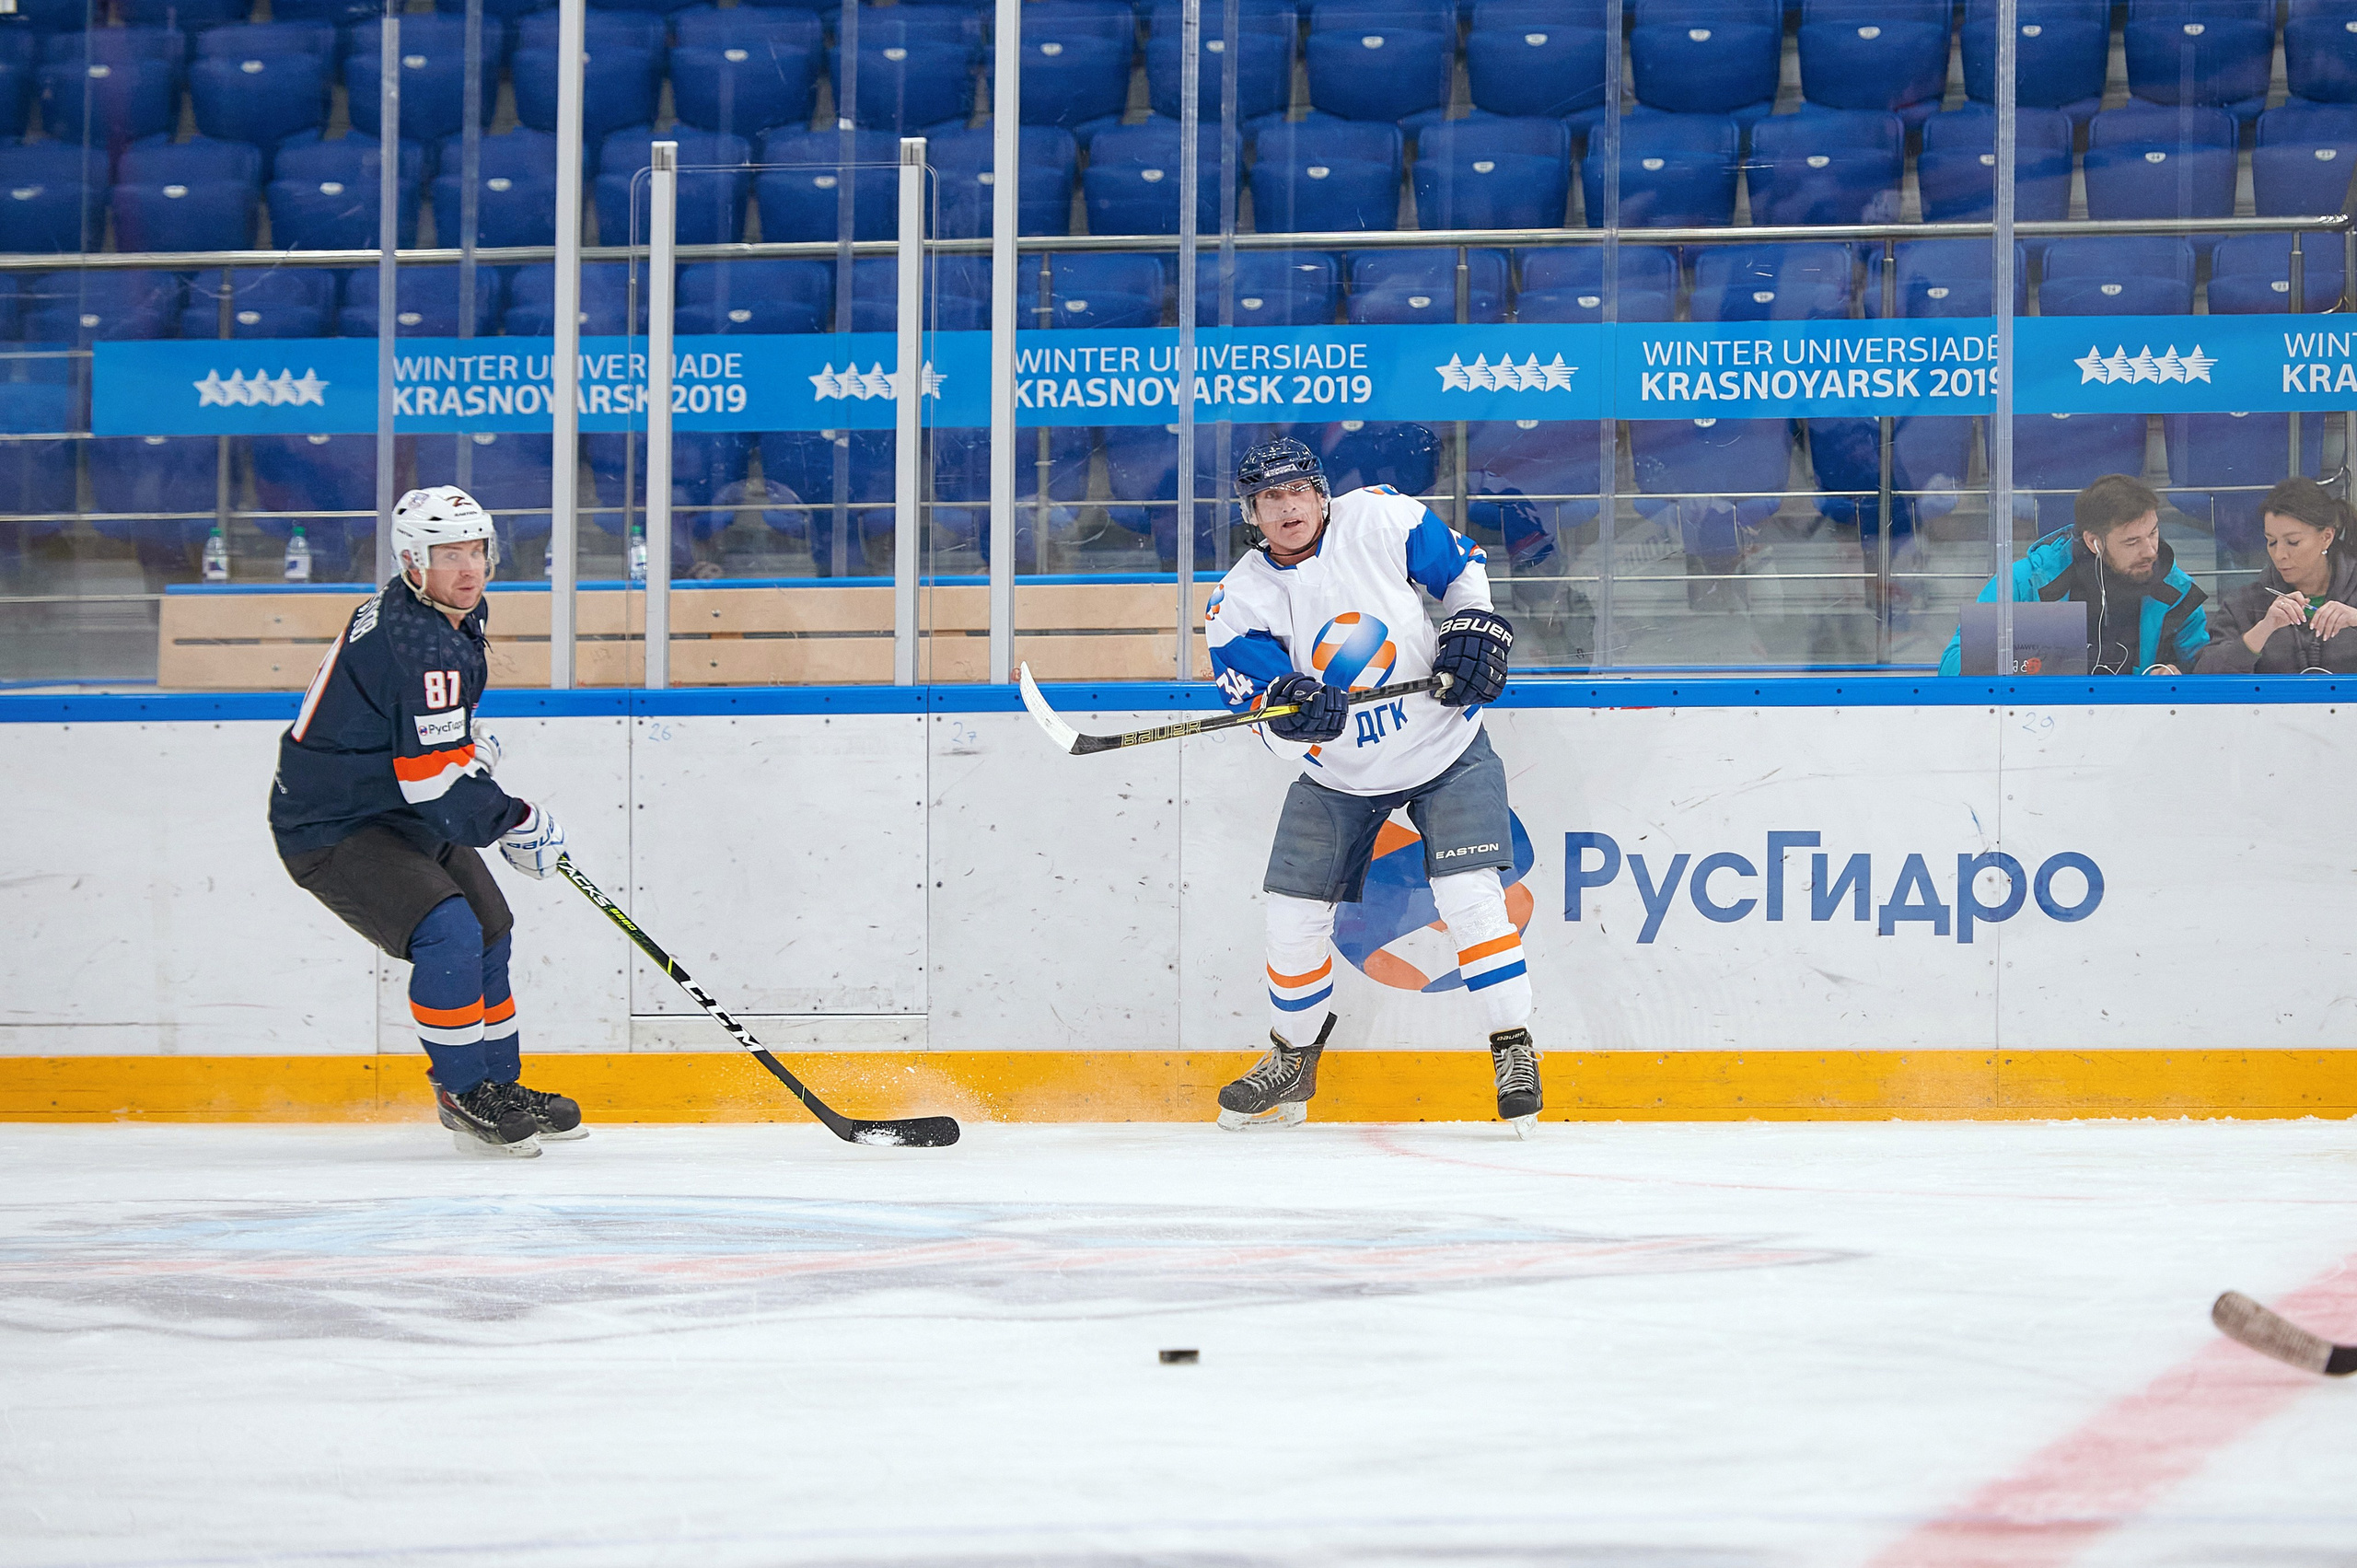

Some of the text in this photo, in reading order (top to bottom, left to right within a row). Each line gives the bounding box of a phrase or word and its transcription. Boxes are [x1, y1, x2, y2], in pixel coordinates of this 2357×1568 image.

[1642, 340, 1774, 366] WINTER
[2283, 331, 2357, 358] WIN
[393, 353, 743, 382] WINTER UIVERIADE
[1016, 346, 1140, 374] WINTER
[671, 383, 747, 413] 2019
[1015, 374, 1373, 408] KRASNOYARSK 2019
[1641, 367, 1922, 401] KRASNOYARSK
[1438, 618, 1514, 647] BAUER
[424, 669, 461, 710] 81
[1215, 667, 1255, 705] 34
[647, 722, 673, 742] 26
[950, 721, 978, 744] 27
[1120, 719, 1202, 749] BAUER
[1354, 696, 1409, 749] ДГК
[2022, 711, 2056, 741] 29
[1435, 842, 1500, 860] EASTON
[1562, 830, 2106, 945] РусГидро
[679, 976, 767, 1054] CCM
[1496, 1029, 1526, 1042] BAUER
